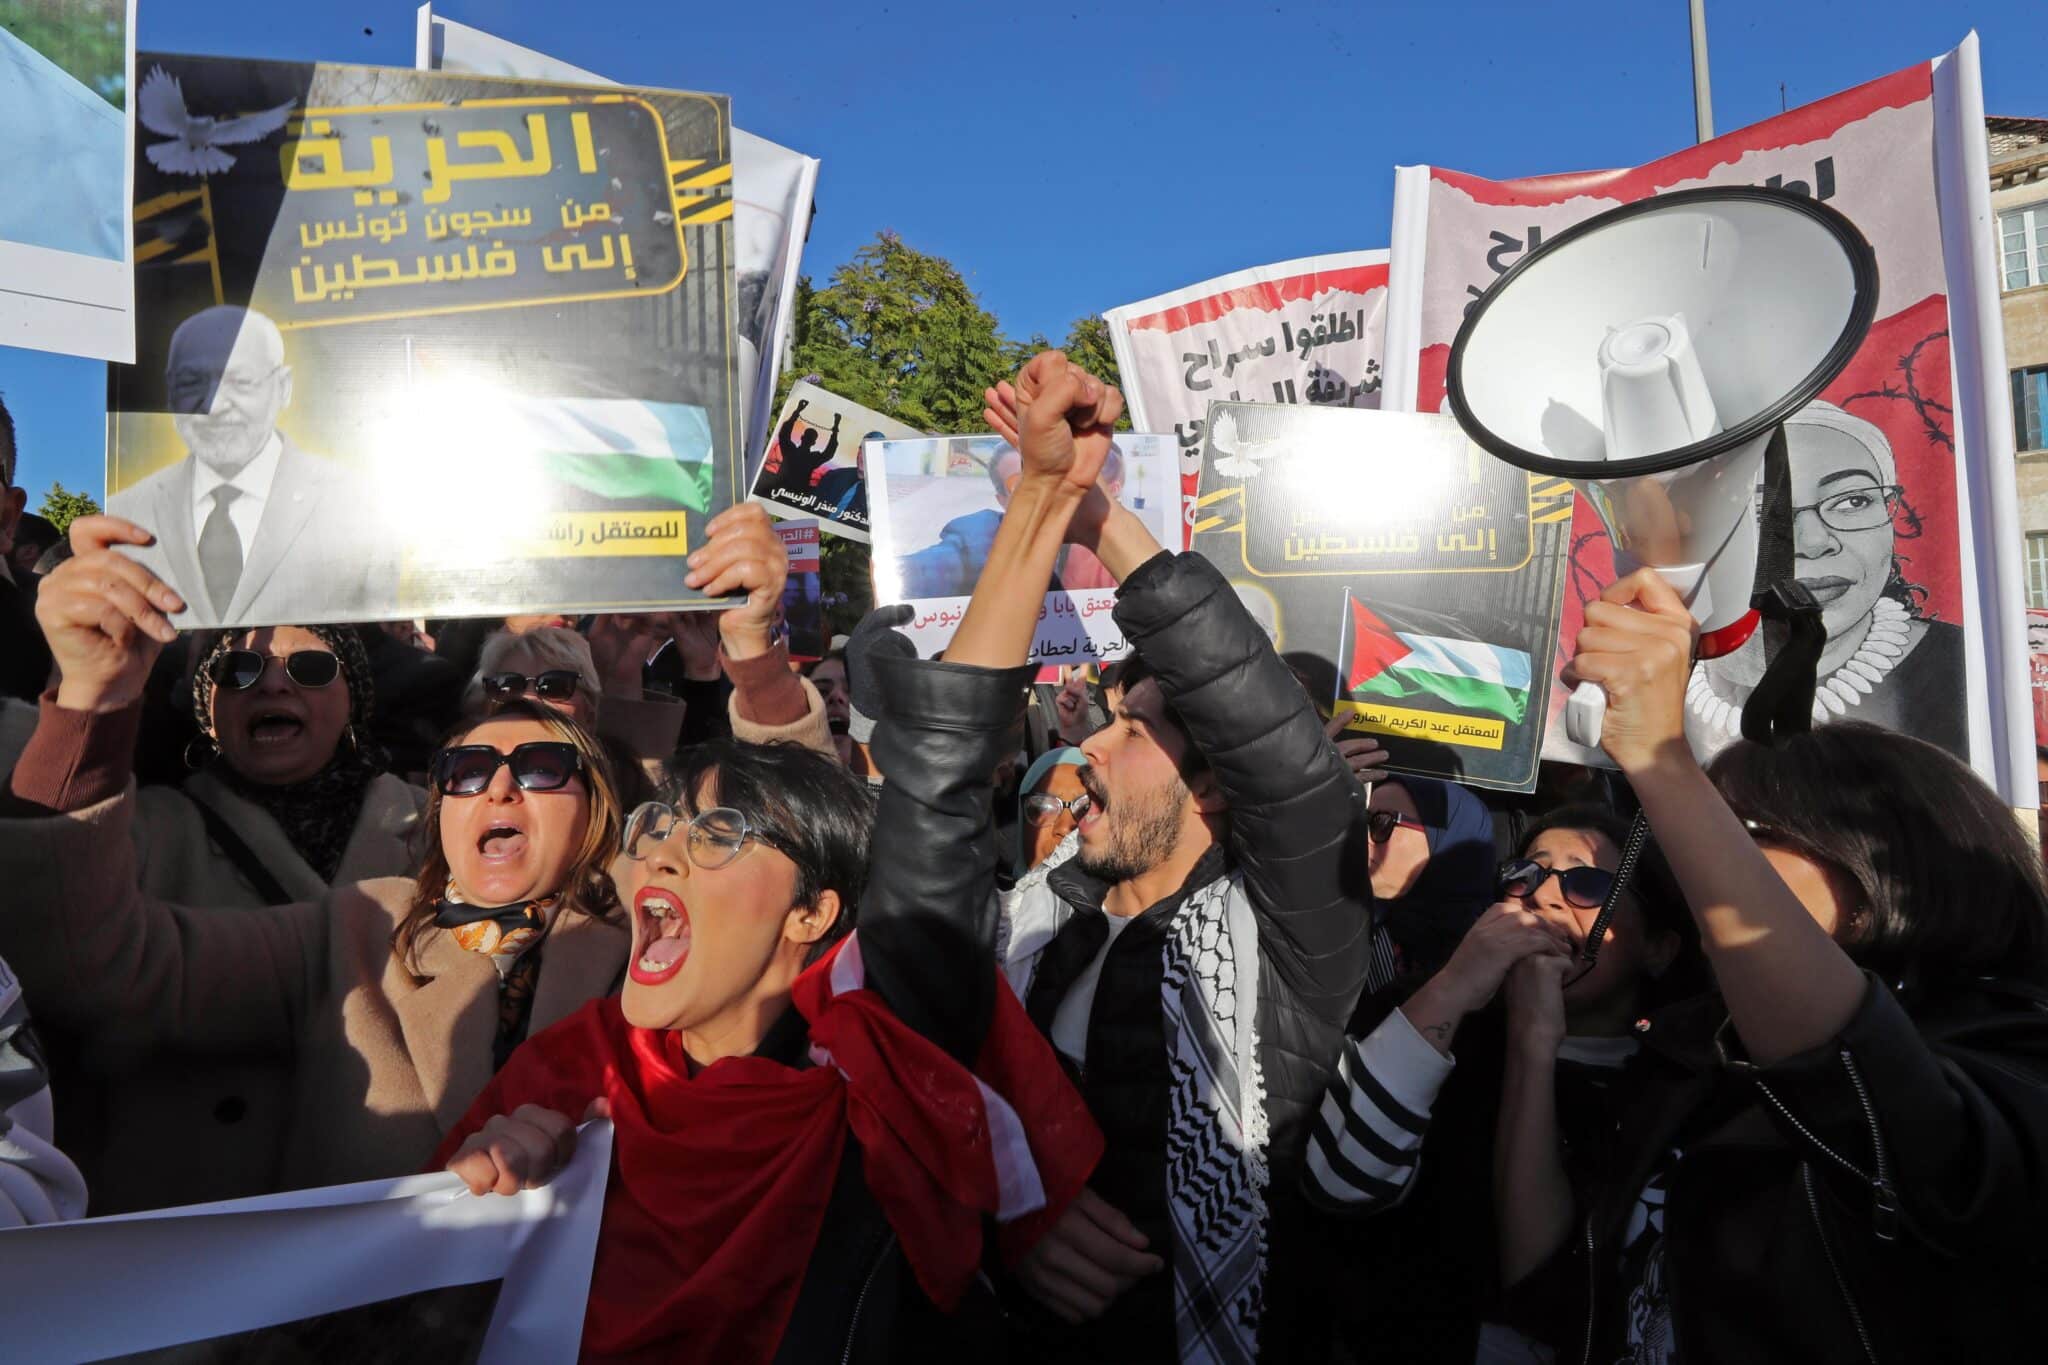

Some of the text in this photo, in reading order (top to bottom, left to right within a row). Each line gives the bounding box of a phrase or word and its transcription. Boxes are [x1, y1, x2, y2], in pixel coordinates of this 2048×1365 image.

[280, 112, 597, 205] الحرية
[300, 199, 611, 248] من سجون تونس
[290, 233, 637, 304] إلى فلسطين
[1183, 308, 1364, 392] اطلقوا سراح
[771, 487, 817, 506] الونيسي
[814, 500, 838, 514] منذر
[592, 520, 679, 544] للمعتقل
[1284, 527, 1497, 561] إلى فلسطين
[1083, 634, 1129, 658] الحرية
[1353, 711, 1500, 739] للمعتقل عبد الكريم الهارو
